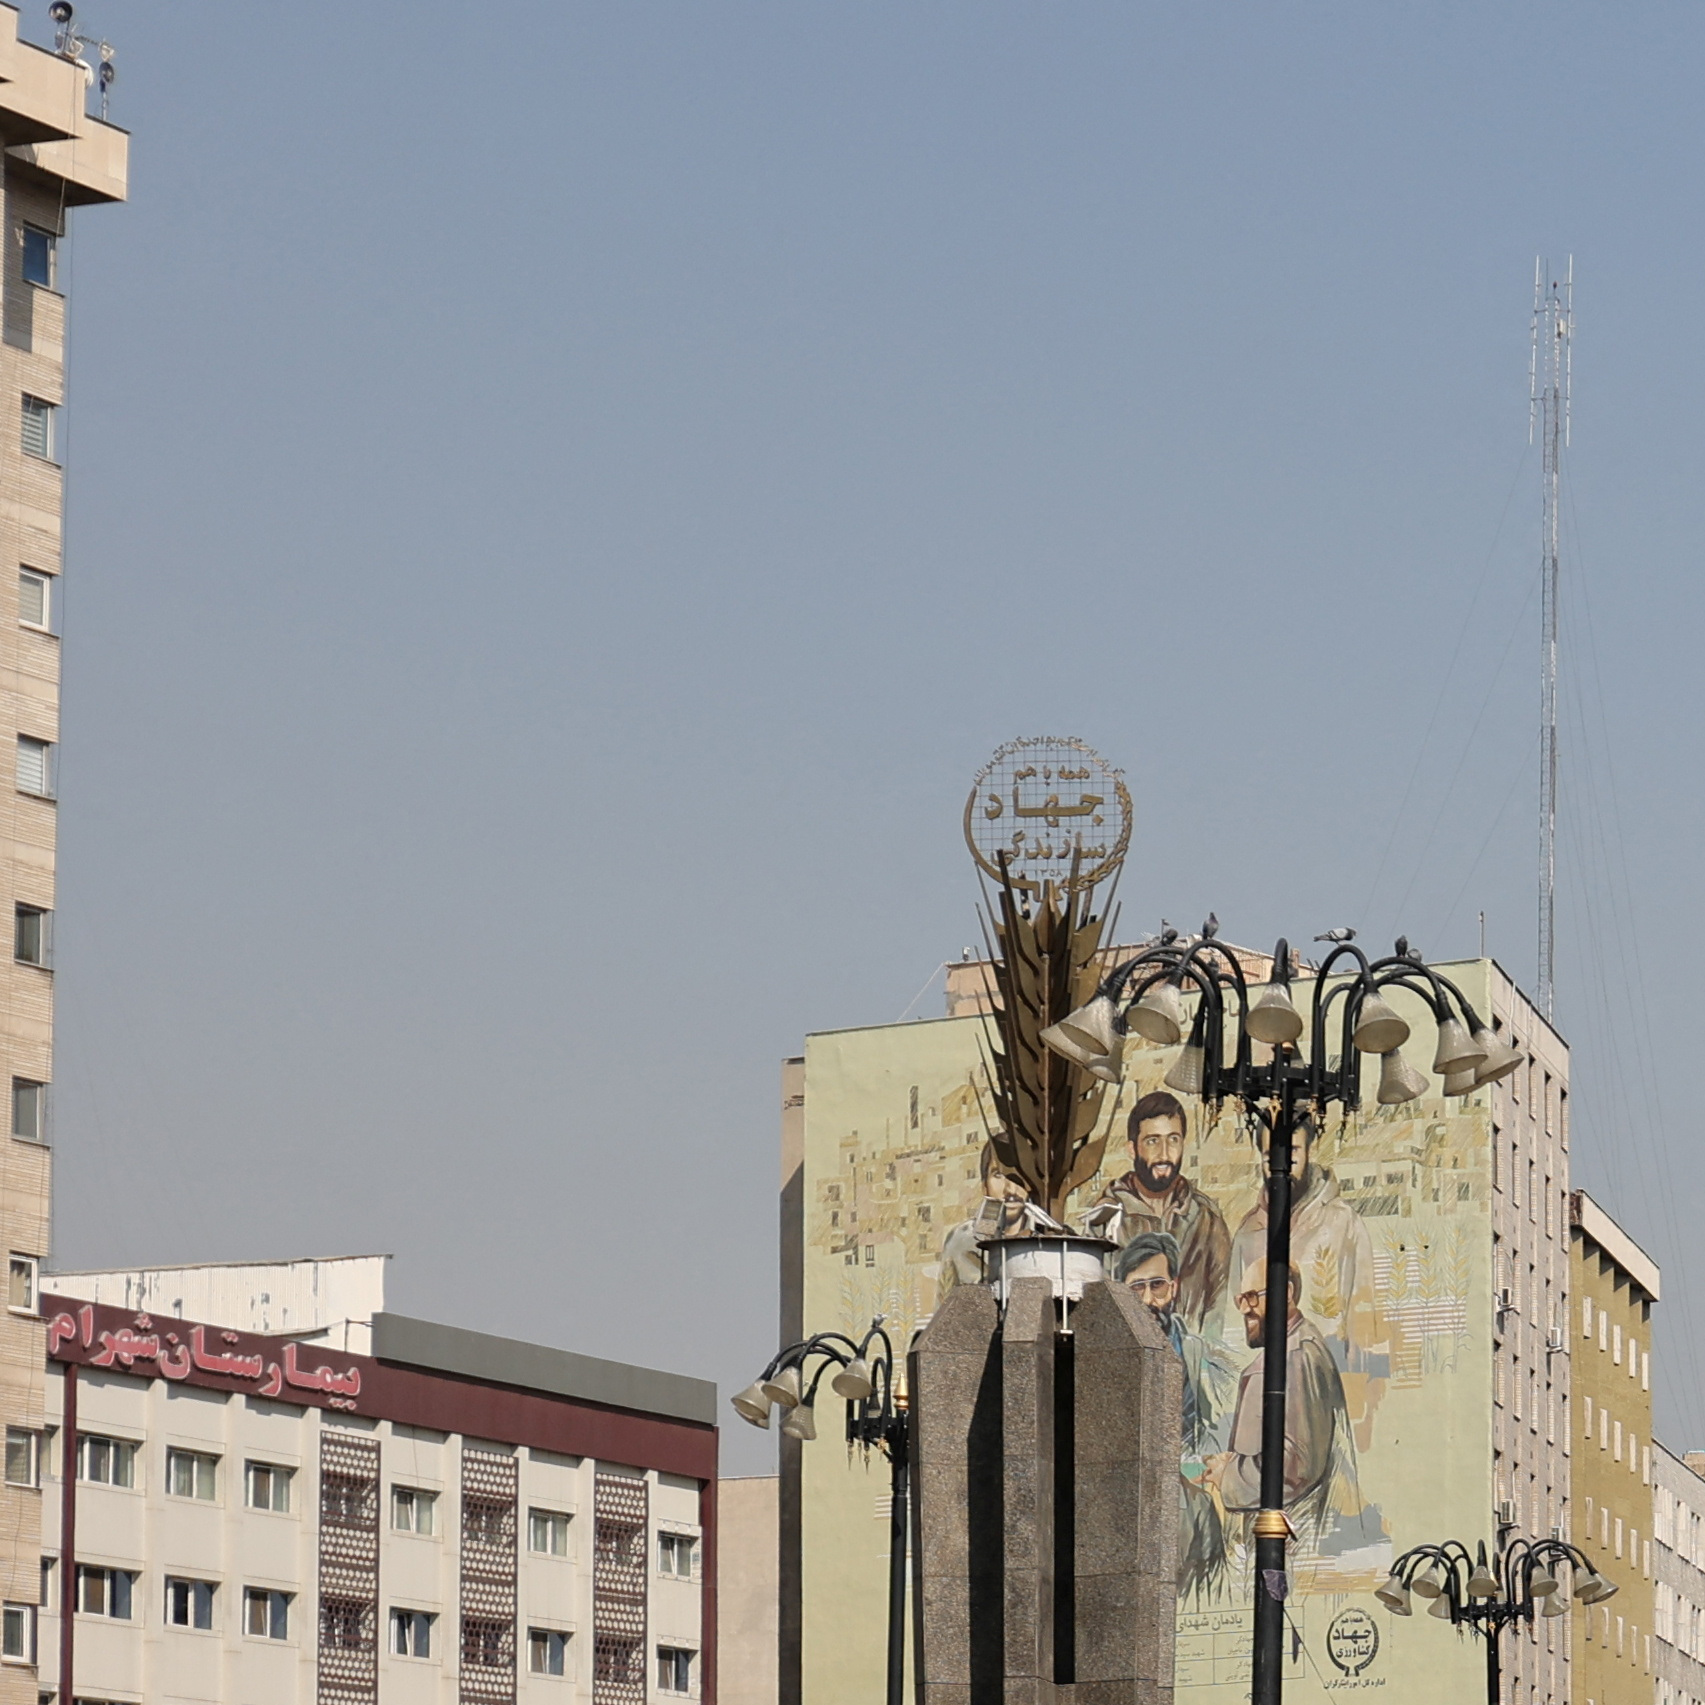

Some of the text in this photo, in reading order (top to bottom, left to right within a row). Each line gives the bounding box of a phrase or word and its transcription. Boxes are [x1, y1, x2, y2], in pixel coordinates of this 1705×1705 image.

[985, 793, 1104, 827] جهاد
[50, 1304, 361, 1410] بیمارستان شهرام
[1333, 1627, 1372, 1644] جهاد
